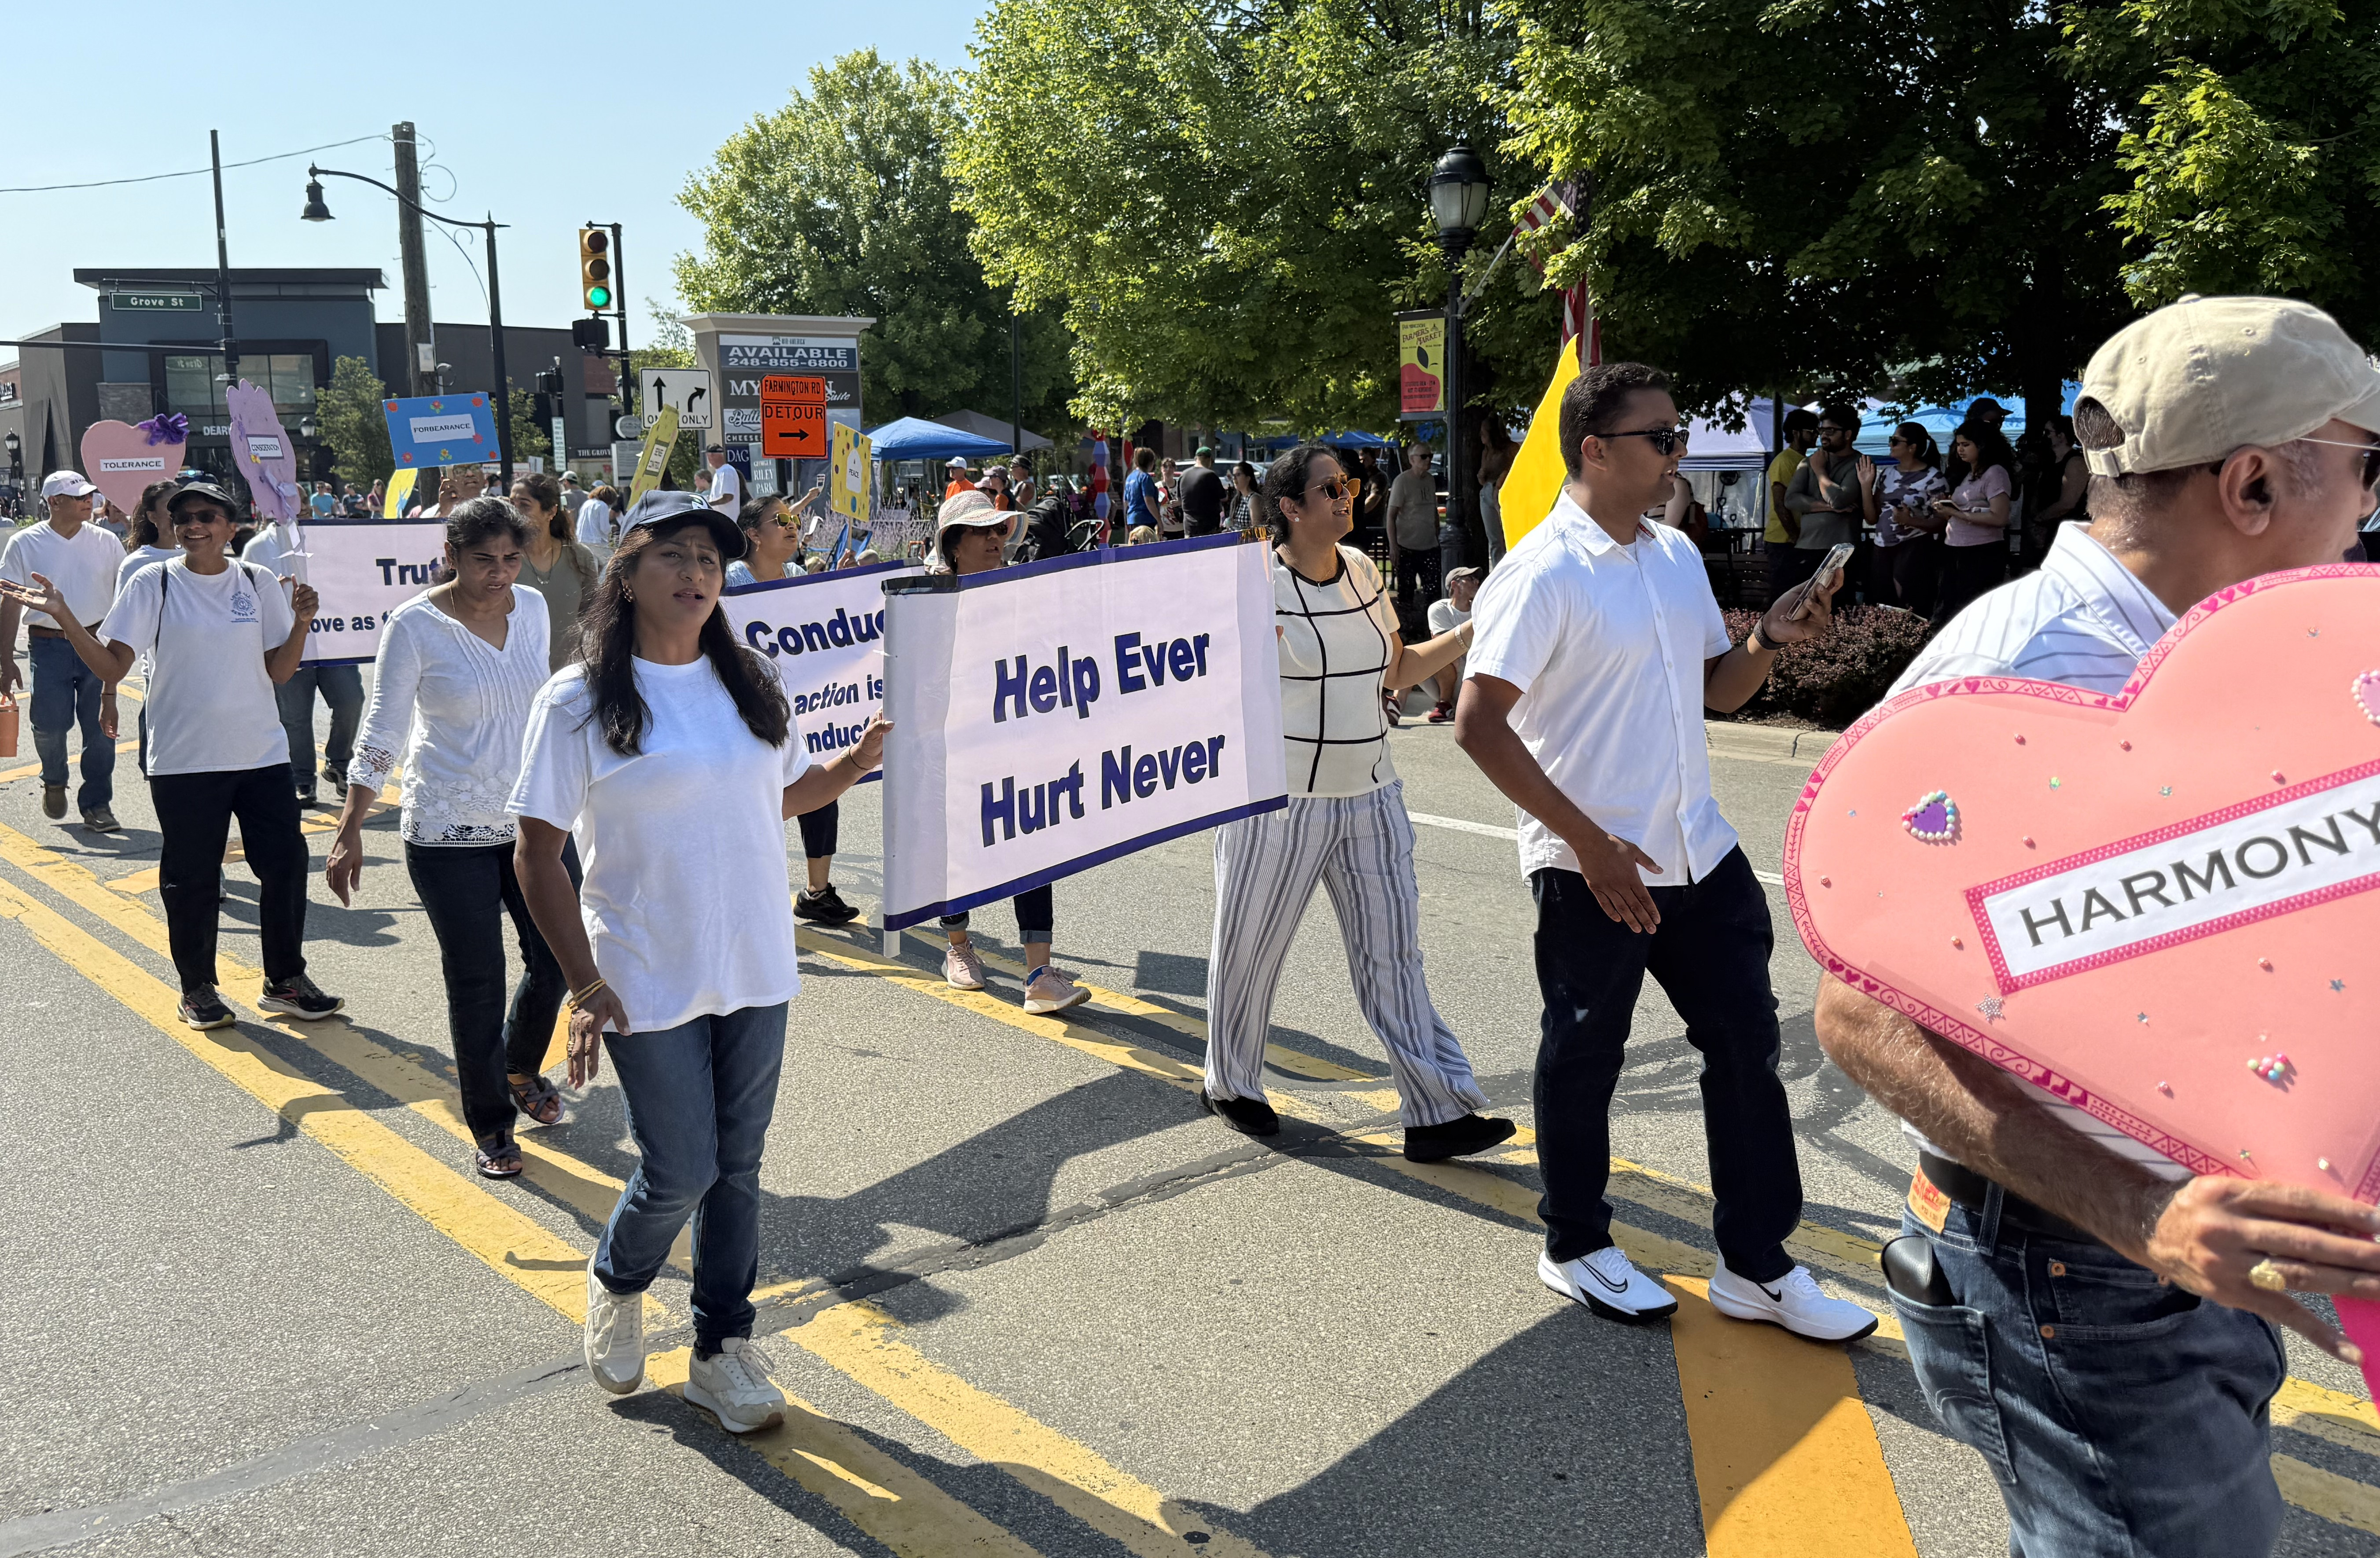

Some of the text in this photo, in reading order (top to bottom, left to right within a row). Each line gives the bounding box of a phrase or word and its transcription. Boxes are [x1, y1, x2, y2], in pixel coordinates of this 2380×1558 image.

[131, 297, 184, 306] Grove St
[1402, 328, 1429, 343] FARMERS
[1416, 331, 1442, 345] MARKET
[729, 347, 847, 359] AVAILABLE
[728, 358, 847, 367] 248-855-6800
[765, 380, 820, 395] FARMINGTON RD
[765, 405, 823, 419] DETOUR
[682, 415, 708, 424] ONLY
[203, 426, 231, 436] DEAR
[414, 423, 470, 433] FORBEARANCE
[754, 469, 773, 481] RILEY
[849, 469, 859, 478] PEACE
[756, 482, 774, 494] PARK
[308, 617, 345, 633] ove
[351, 616, 376, 631] as
[993, 631, 1210, 724] Help Ever
[795, 682, 859, 716] action
[801, 716, 870, 754] nduc
[980, 734, 1225, 848] Hurt Never
